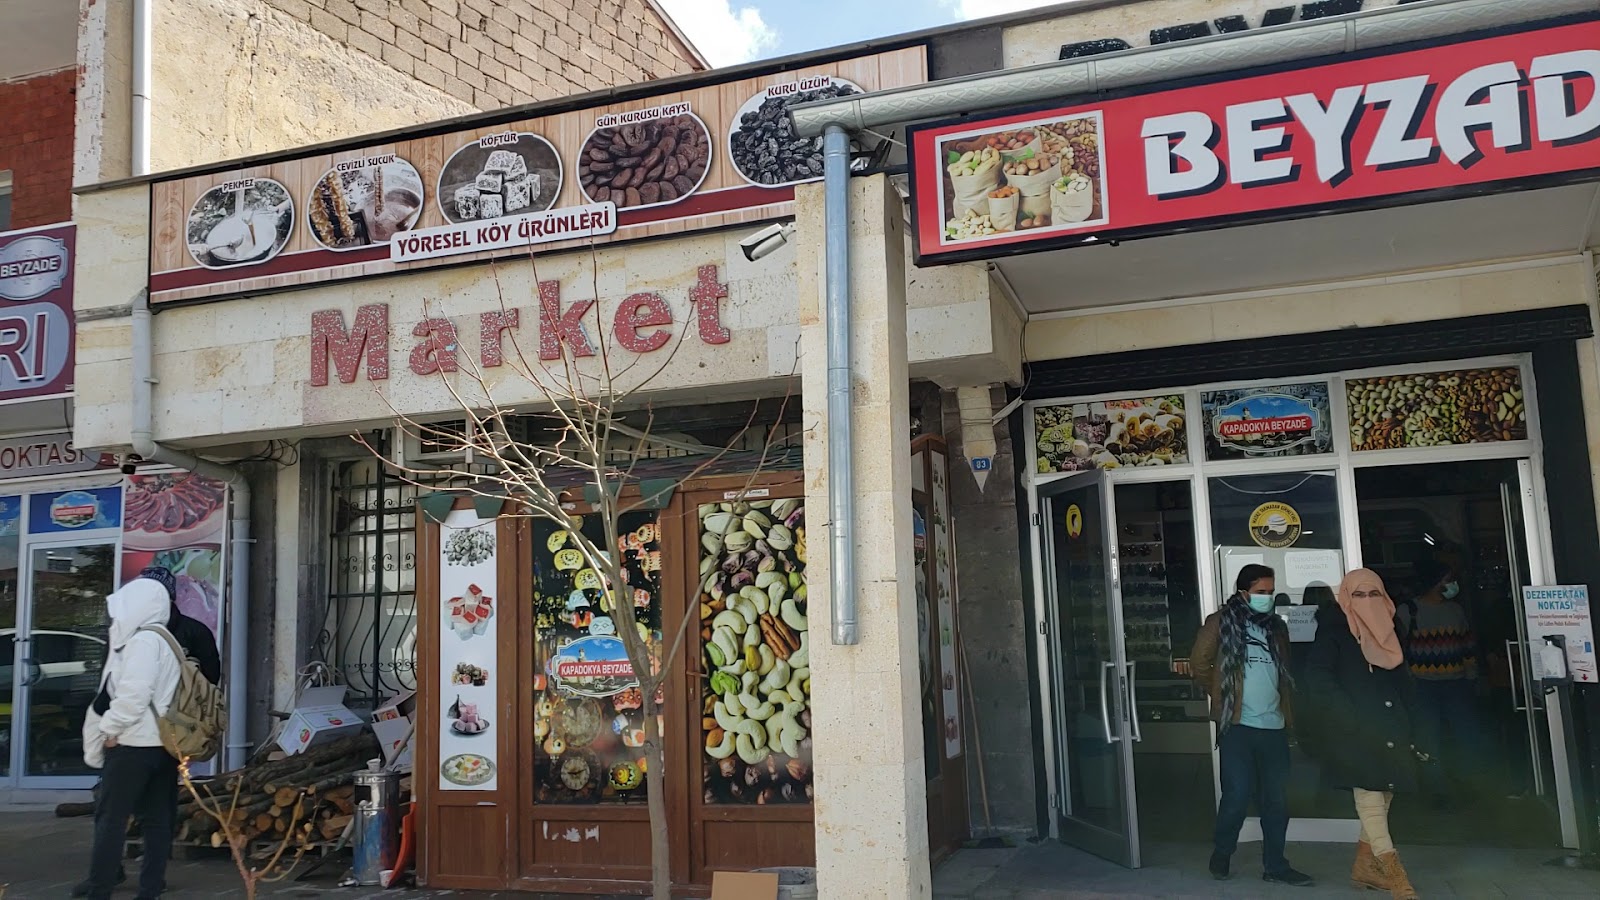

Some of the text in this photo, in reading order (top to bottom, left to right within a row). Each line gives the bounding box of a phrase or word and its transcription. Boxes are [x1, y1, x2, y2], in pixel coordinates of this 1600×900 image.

[767, 76, 830, 97] KURU ÜZÜM
[596, 103, 690, 128] GÜN KURUSU KAYSI
[480, 132, 518, 147] KÖFTÜR
[336, 154, 395, 172] CEVİZLİ SUCUK
[223, 178, 254, 191] PEKMEZ
[397, 205, 610, 256] YÖRESEL KÖY ÜRÜNLERİ
[1, 256, 59, 277] BEYZADE
[310, 264, 731, 387] Market
[1223, 418, 1307, 435] KAPADOKYA BEYZADE
[1526, 590, 1585, 599] DEZENFEKTAN
[1538, 601, 1574, 610] NOKTASI
[561, 663, 633, 676] KAPADOKYA BEYZADE
